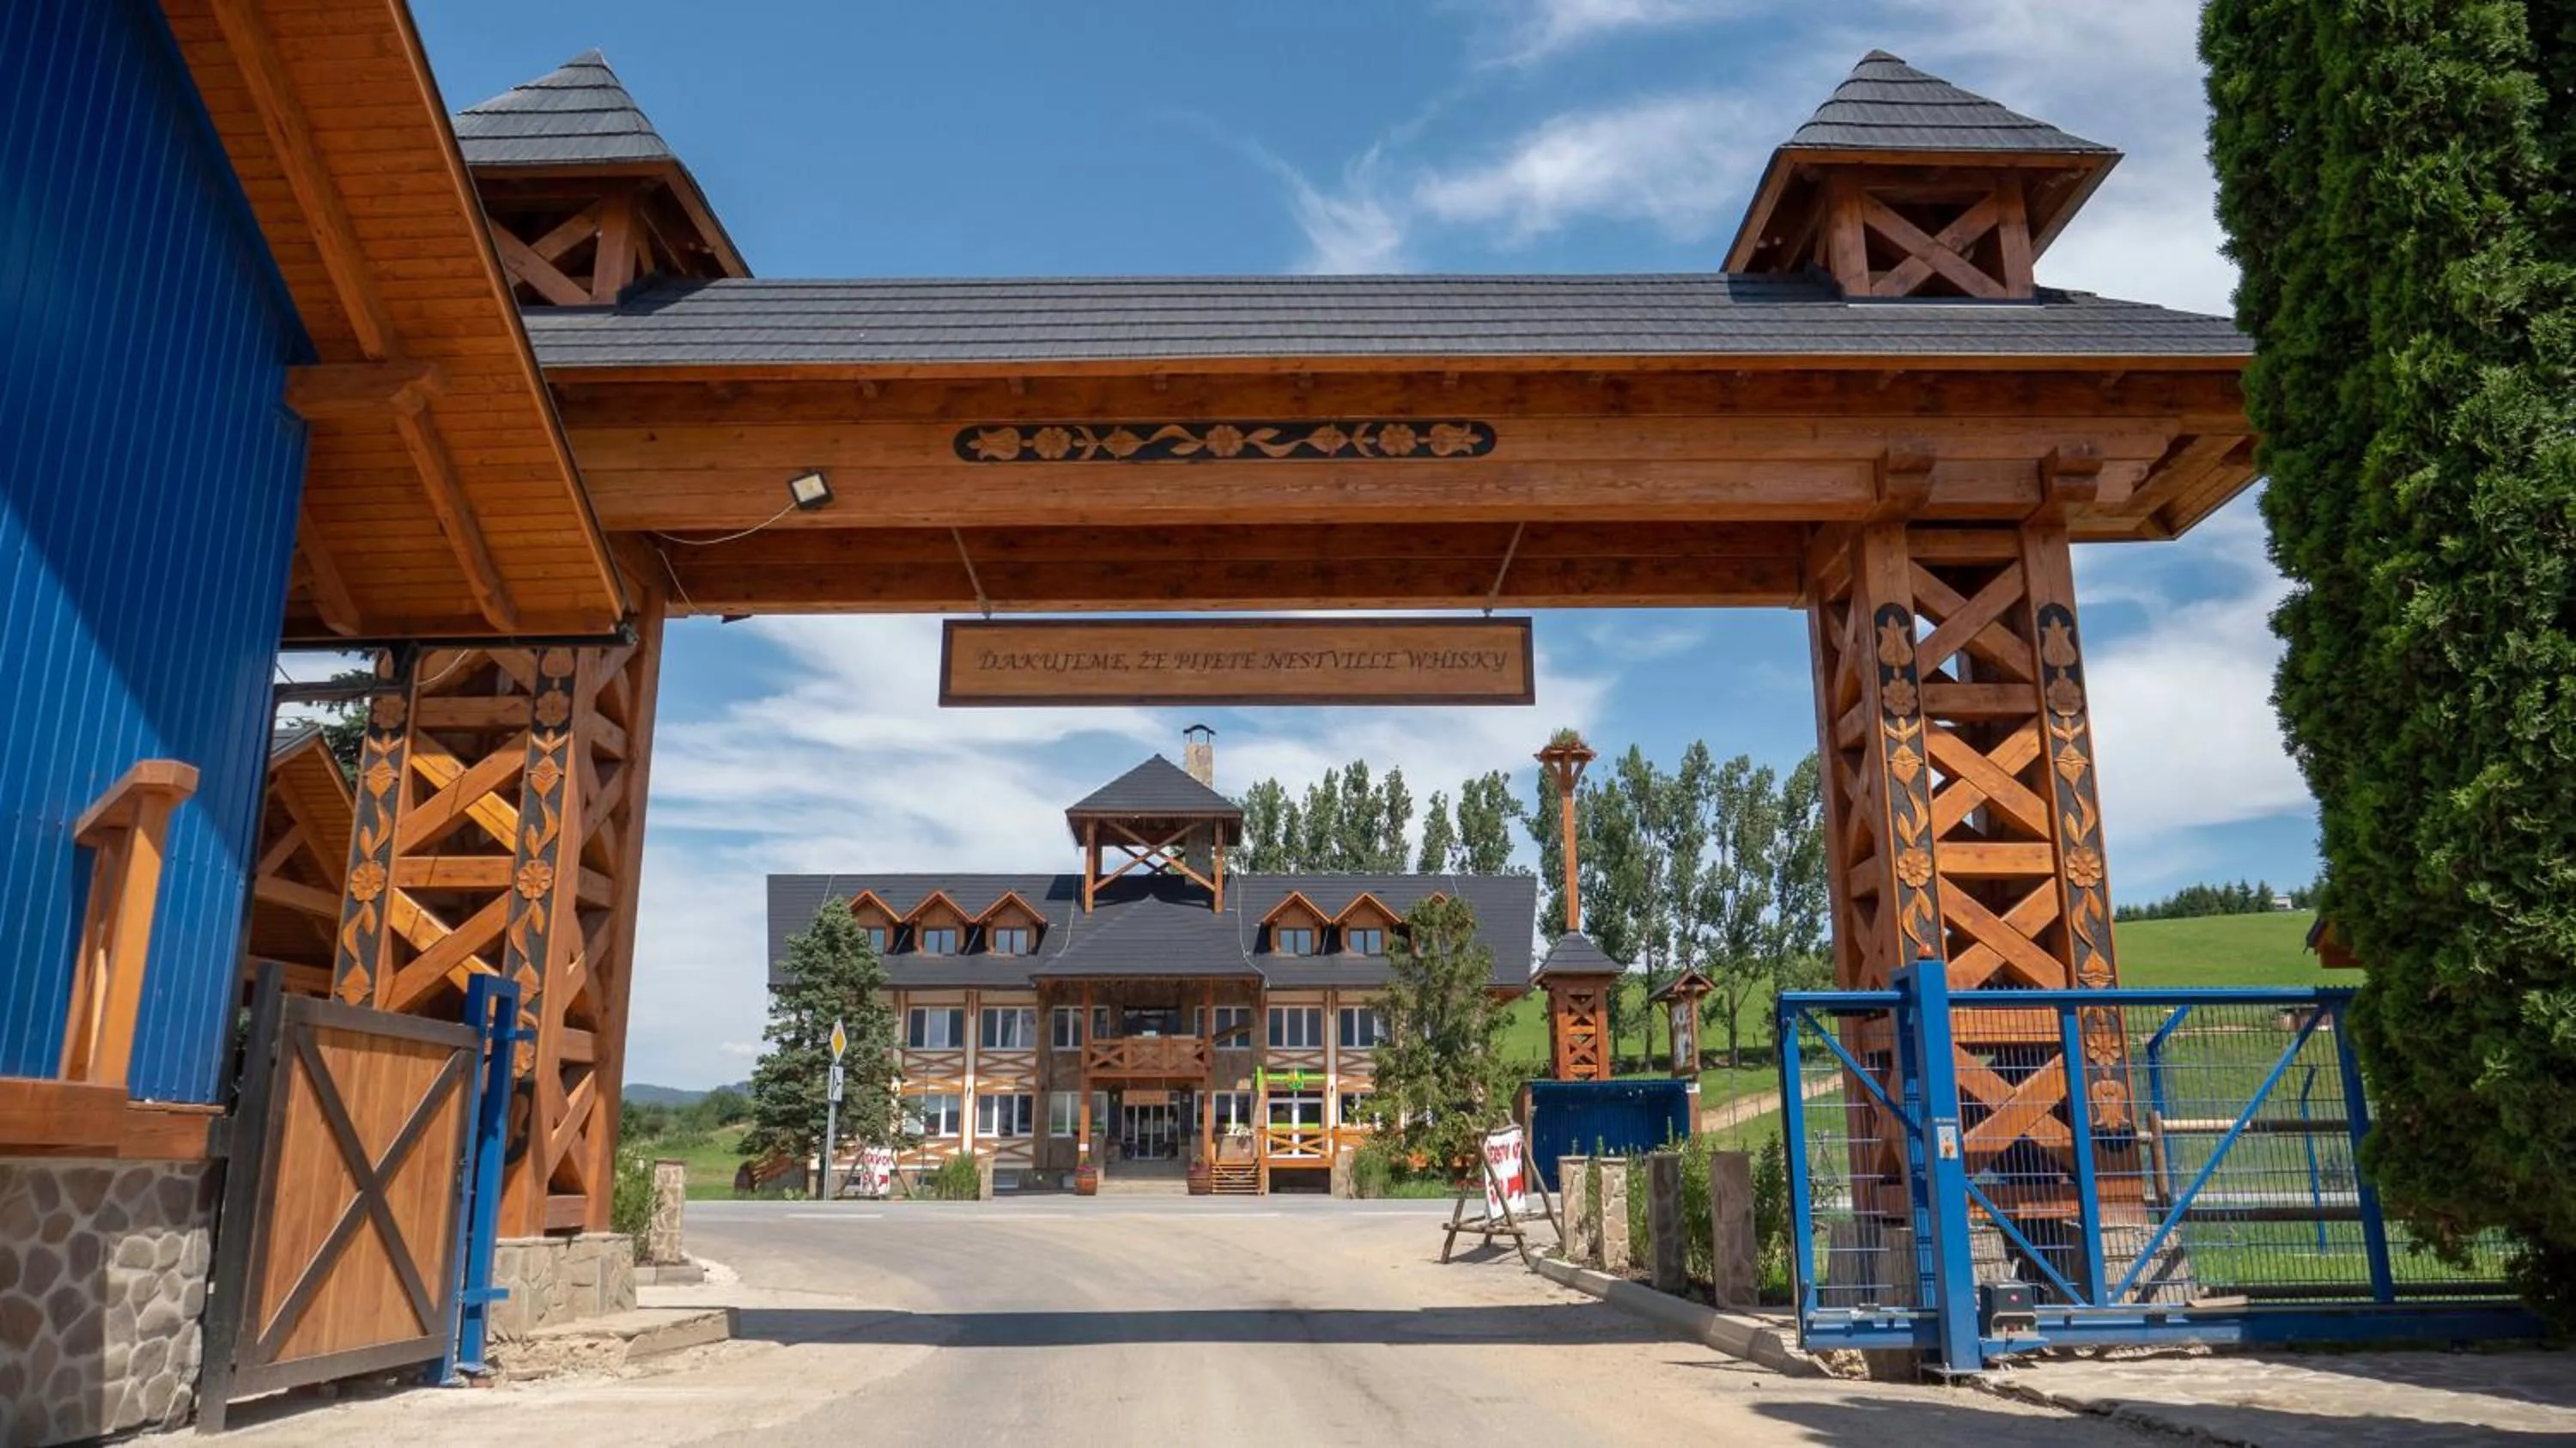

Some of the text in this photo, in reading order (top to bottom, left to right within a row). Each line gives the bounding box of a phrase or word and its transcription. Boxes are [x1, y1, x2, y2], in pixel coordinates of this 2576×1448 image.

[1138, 650, 1169, 670] ŽE
[1262, 650, 1398, 670] NESTVILLE
[1403, 650, 1508, 672] WHISKY
